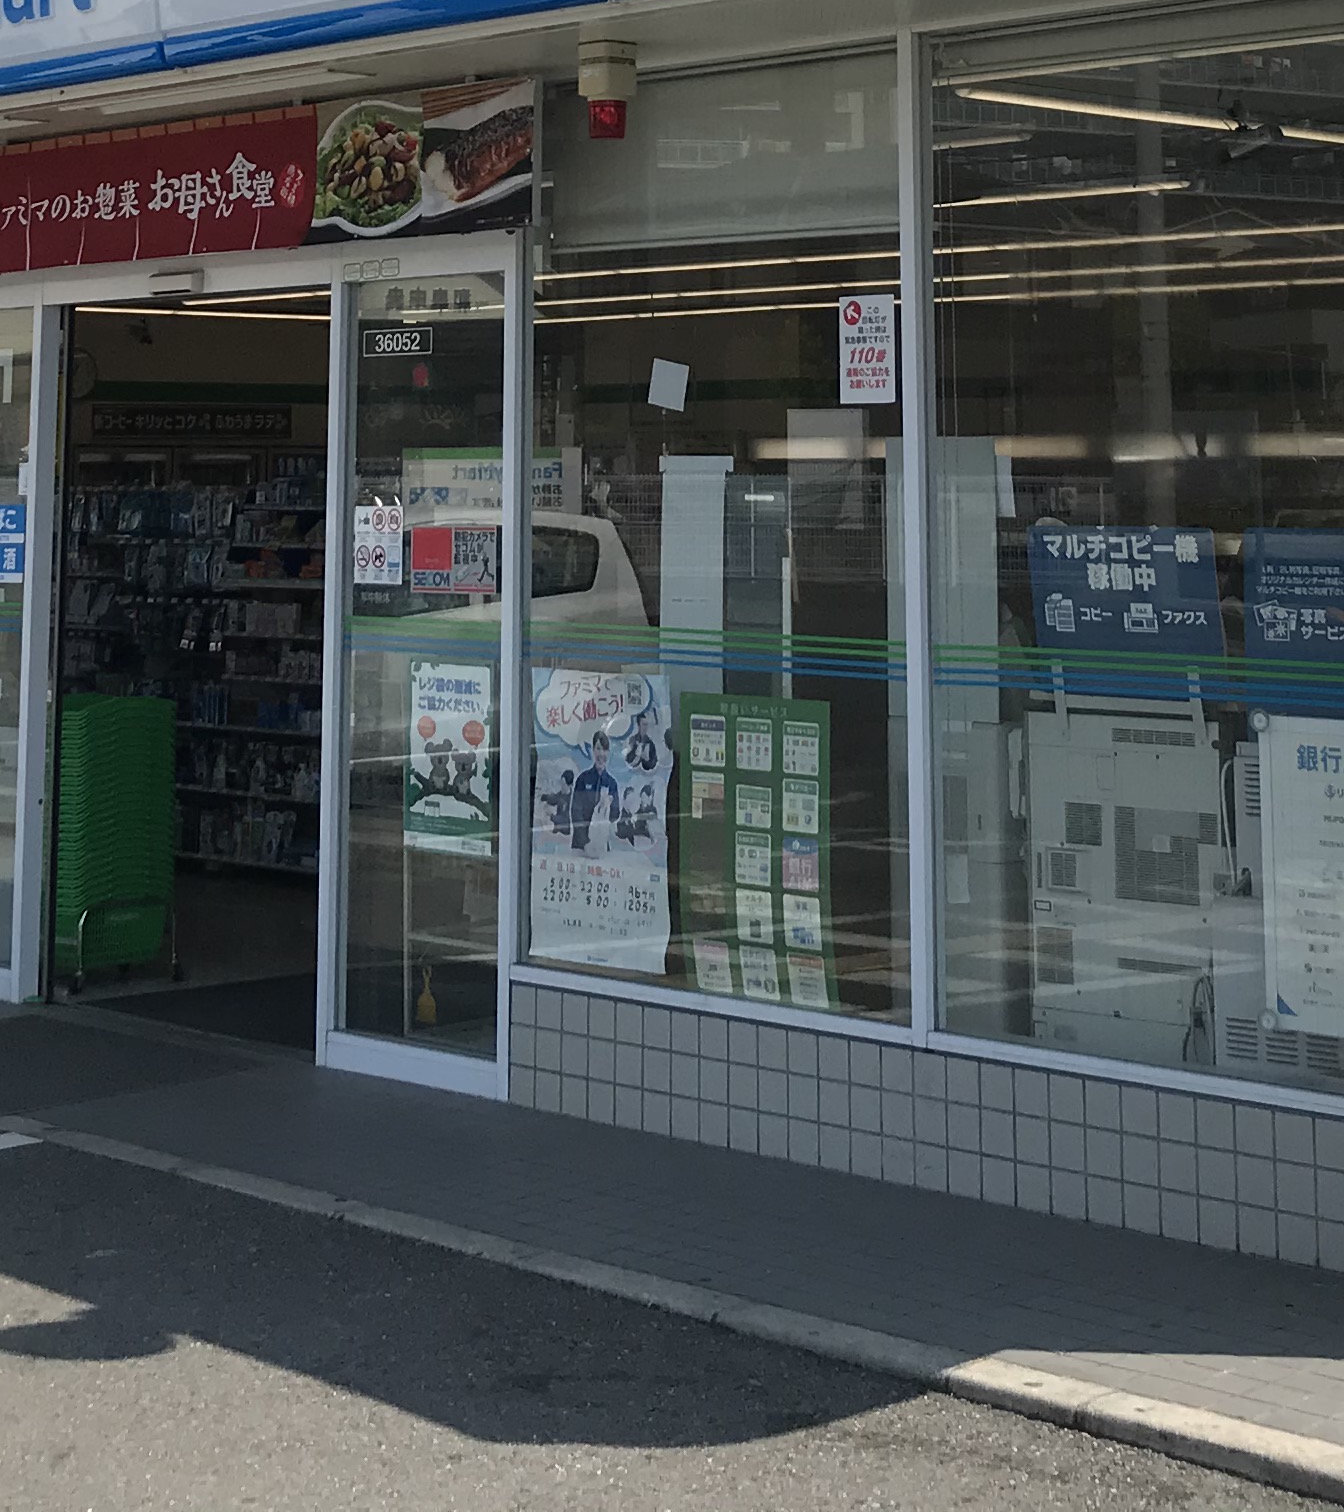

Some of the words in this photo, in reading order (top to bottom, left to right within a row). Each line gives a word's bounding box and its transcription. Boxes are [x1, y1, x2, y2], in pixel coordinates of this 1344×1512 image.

[148, 152, 275, 219] お母さん食堂
[375, 332, 421, 353] 36052
[849, 346, 887, 364] 110番
[849, 378, 888, 390] お願いします
[1042, 534, 1200, 564] マルチコピー機
[413, 572, 450, 587] SECOM
[1086, 562, 1157, 592] 稼働中
[1079, 606, 1113, 621] コピー
[1161, 609, 1208, 625] ファクス
[1300, 608, 1326, 624] 写真
